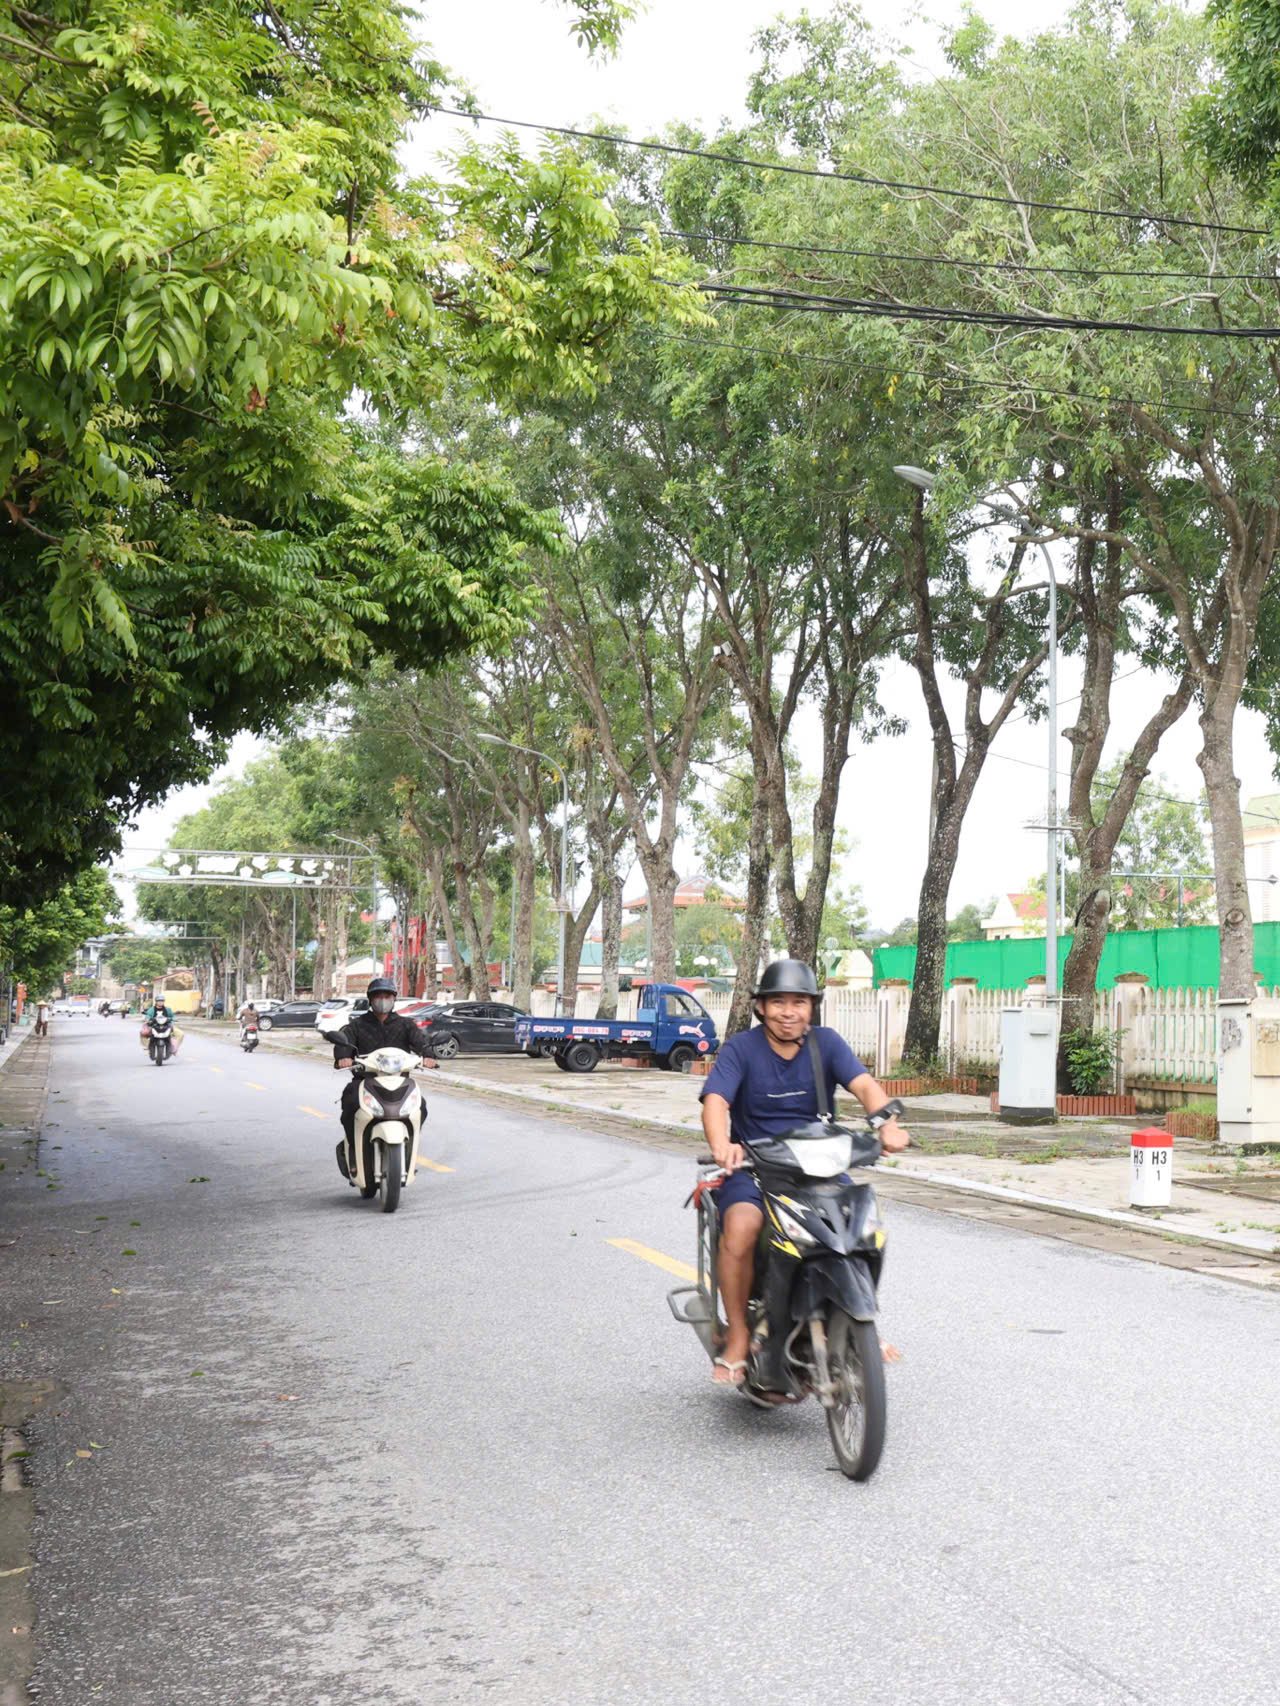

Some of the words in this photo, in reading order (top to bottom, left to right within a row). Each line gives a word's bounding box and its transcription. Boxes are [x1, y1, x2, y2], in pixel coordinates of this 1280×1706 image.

[1133, 1149, 1144, 1165] H3
[1151, 1150, 1167, 1165] H3
[1156, 1169, 1161, 1181] 1
